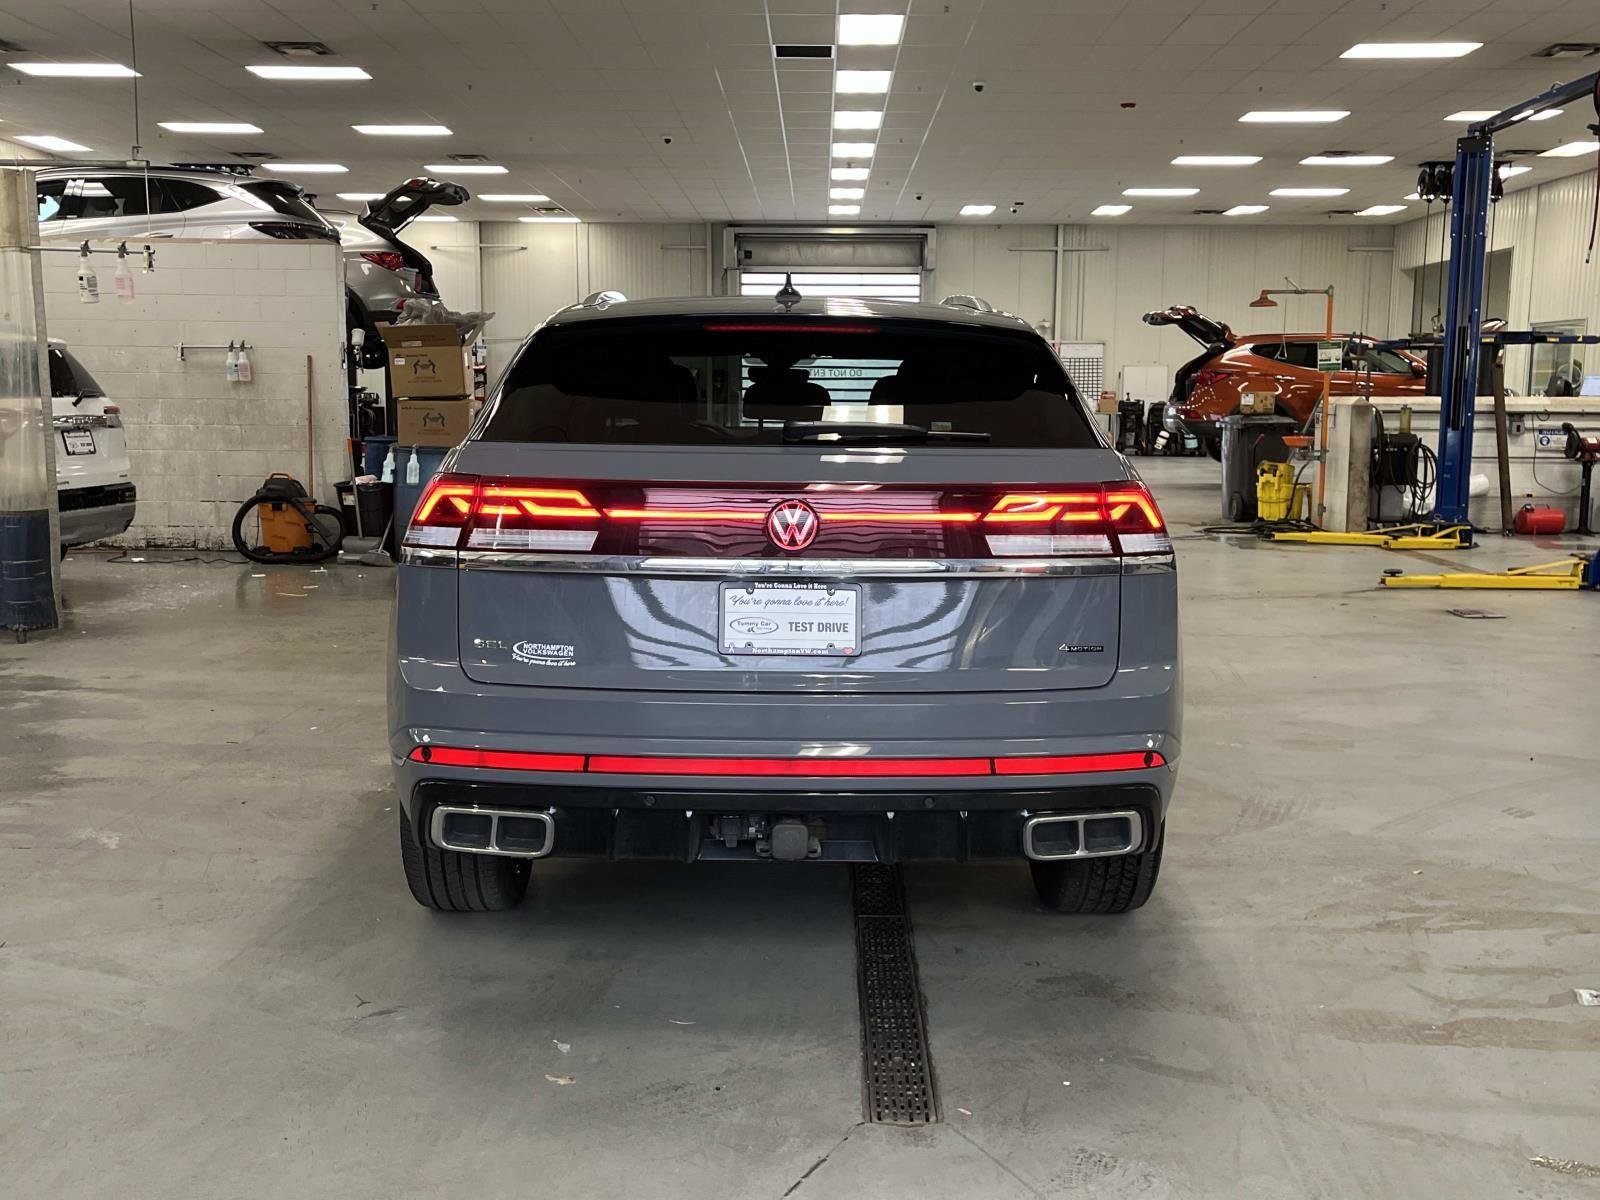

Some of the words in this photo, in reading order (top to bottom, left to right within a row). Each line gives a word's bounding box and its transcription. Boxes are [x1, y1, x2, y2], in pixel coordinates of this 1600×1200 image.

[729, 595, 762, 607] You're
[763, 599, 793, 609] gonna
[793, 596, 813, 606] love
[814, 597, 825, 606] it
[824, 597, 849, 607] here!
[788, 621, 814, 632] TEST
[817, 622, 849, 633] DRIVE
[523, 643, 574, 652] NORTHAMPTON
[523, 648, 574, 657] VOLKSWAGEN
